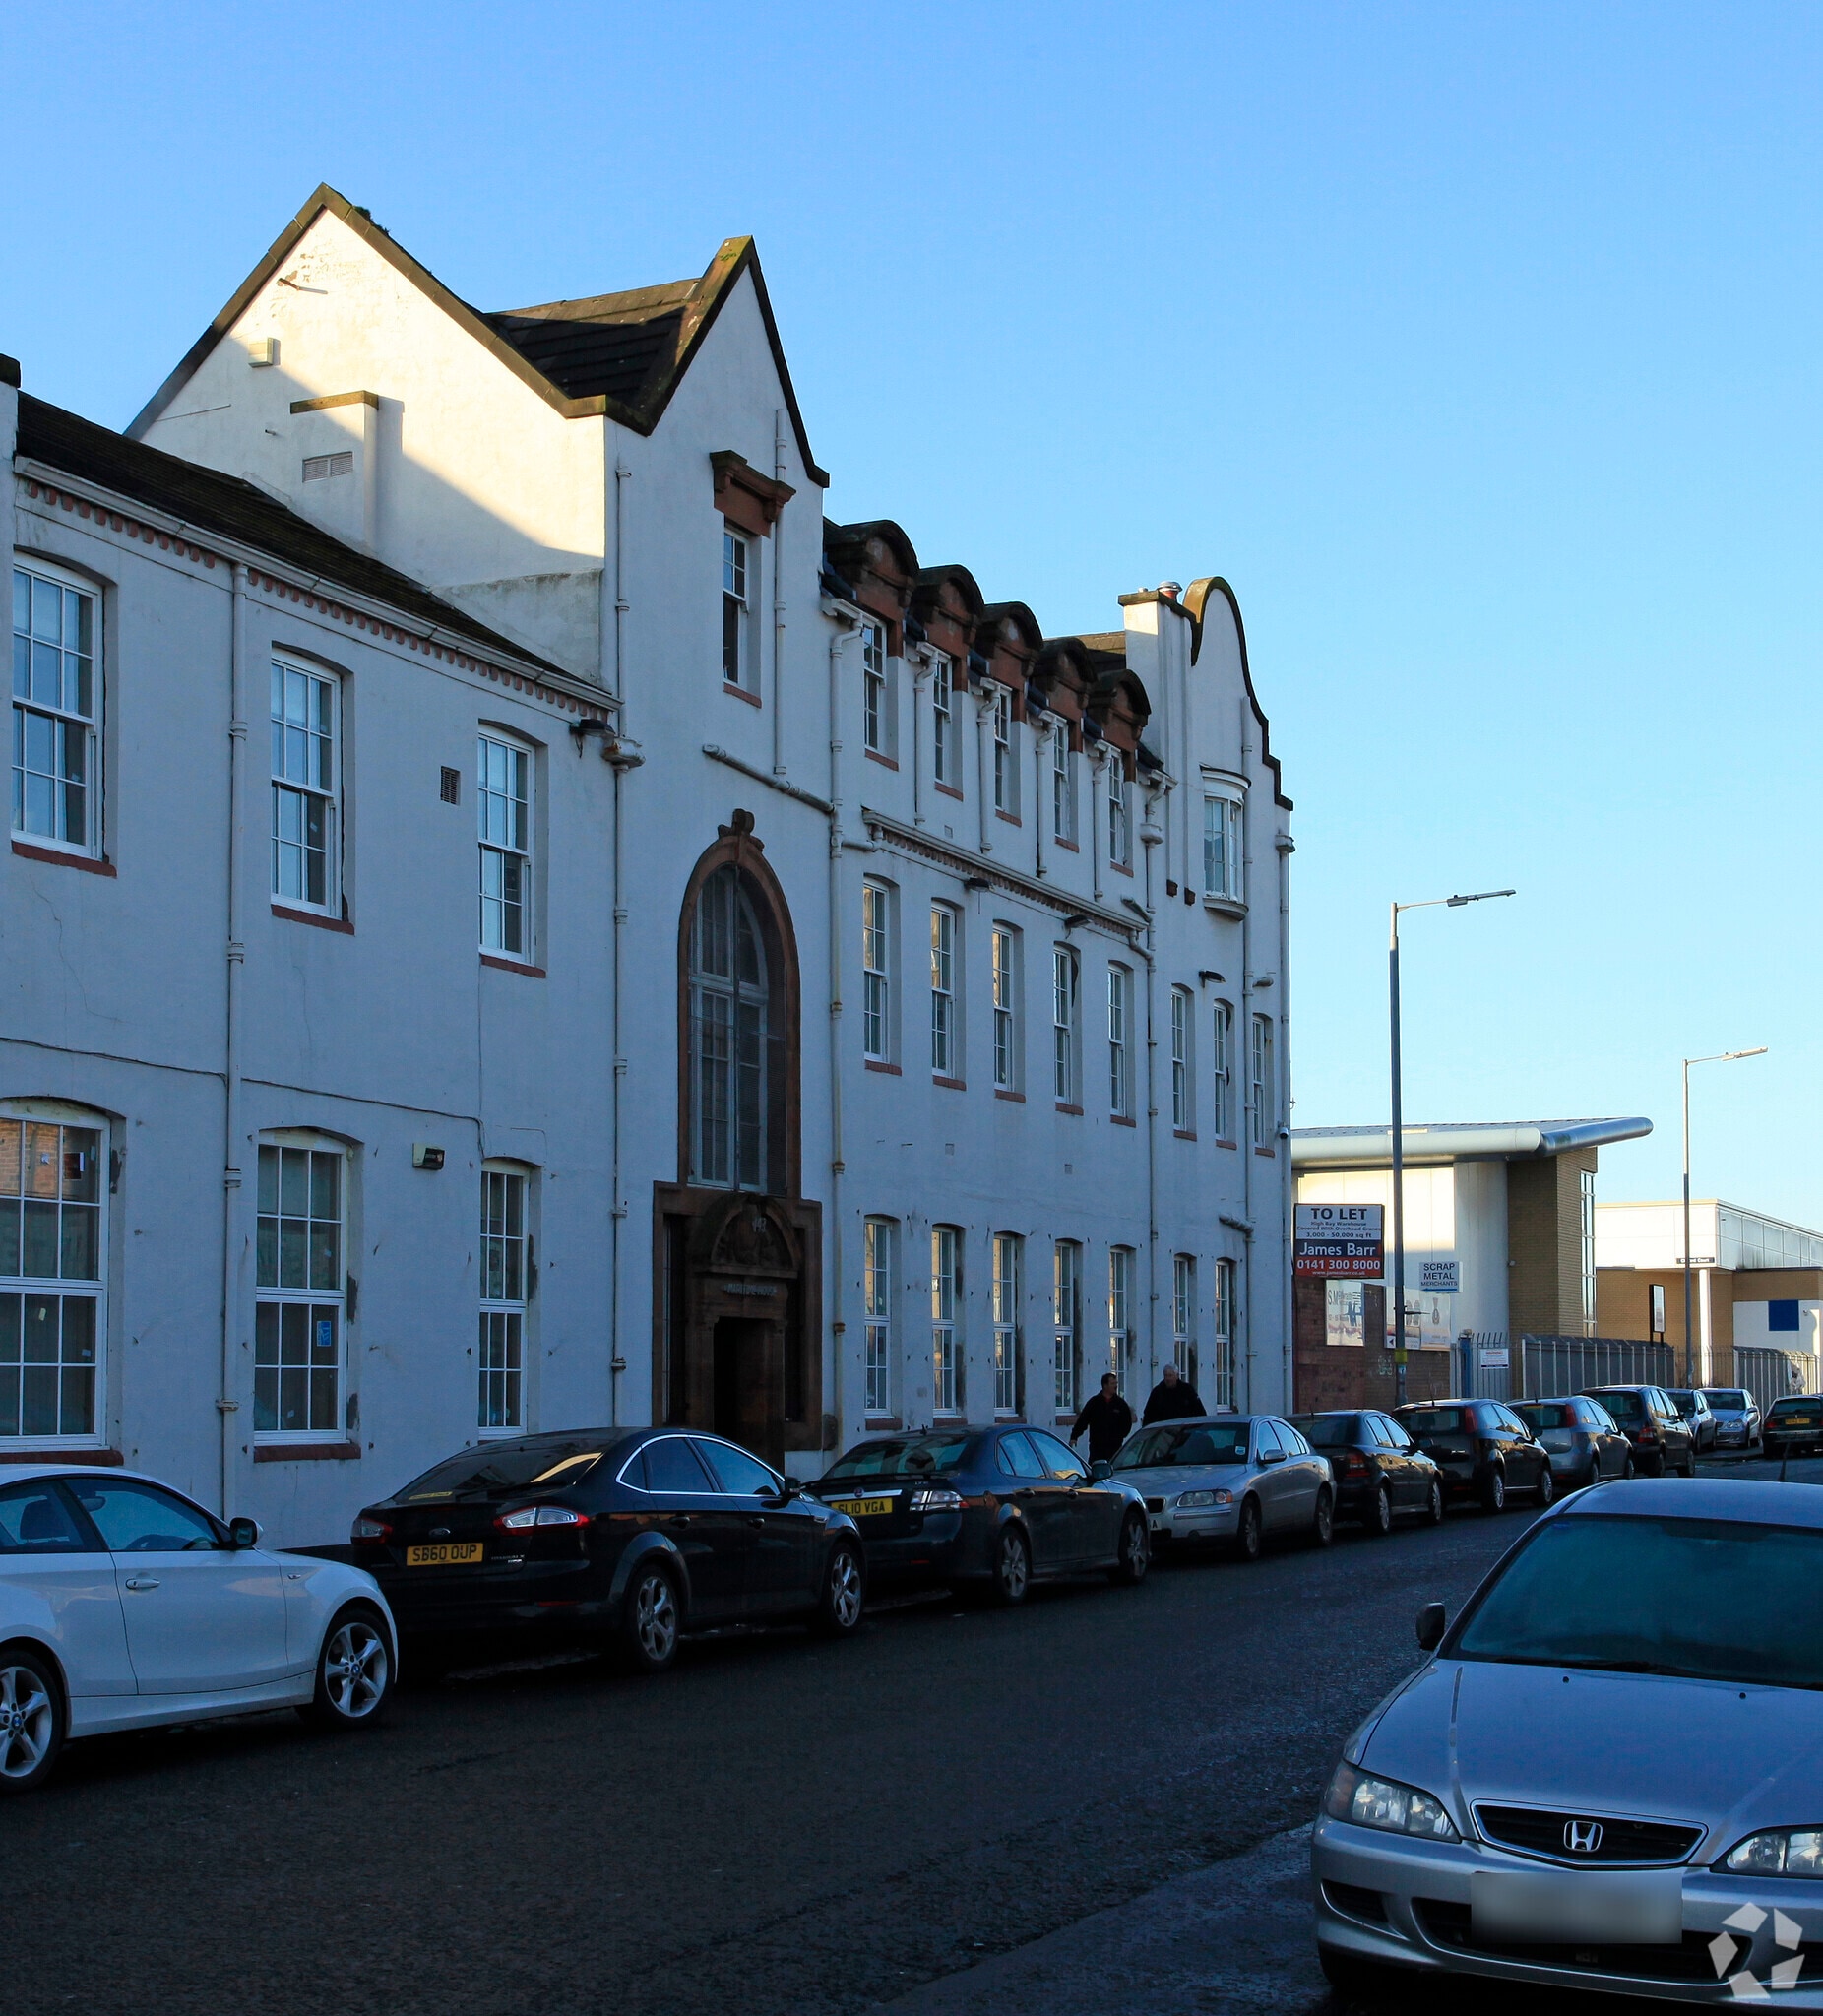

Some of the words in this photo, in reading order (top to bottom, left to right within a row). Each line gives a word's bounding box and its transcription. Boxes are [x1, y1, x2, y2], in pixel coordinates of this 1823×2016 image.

[1310, 1208, 1333, 1220] TO
[1339, 1208, 1367, 1220] LET
[1299, 1242, 1342, 1256] James
[1347, 1242, 1376, 1256] Barr
[1297, 1259, 1325, 1270] 0141
[1328, 1260, 1350, 1270] 300
[1352, 1260, 1381, 1270] 8000
[1423, 1262, 1455, 1271] SCRAP
[838, 1502, 861, 1515] SL10
[864, 1501, 886, 1514] VGA
[412, 1545, 447, 1562] SB60
[451, 1544, 477, 1560] OUP
